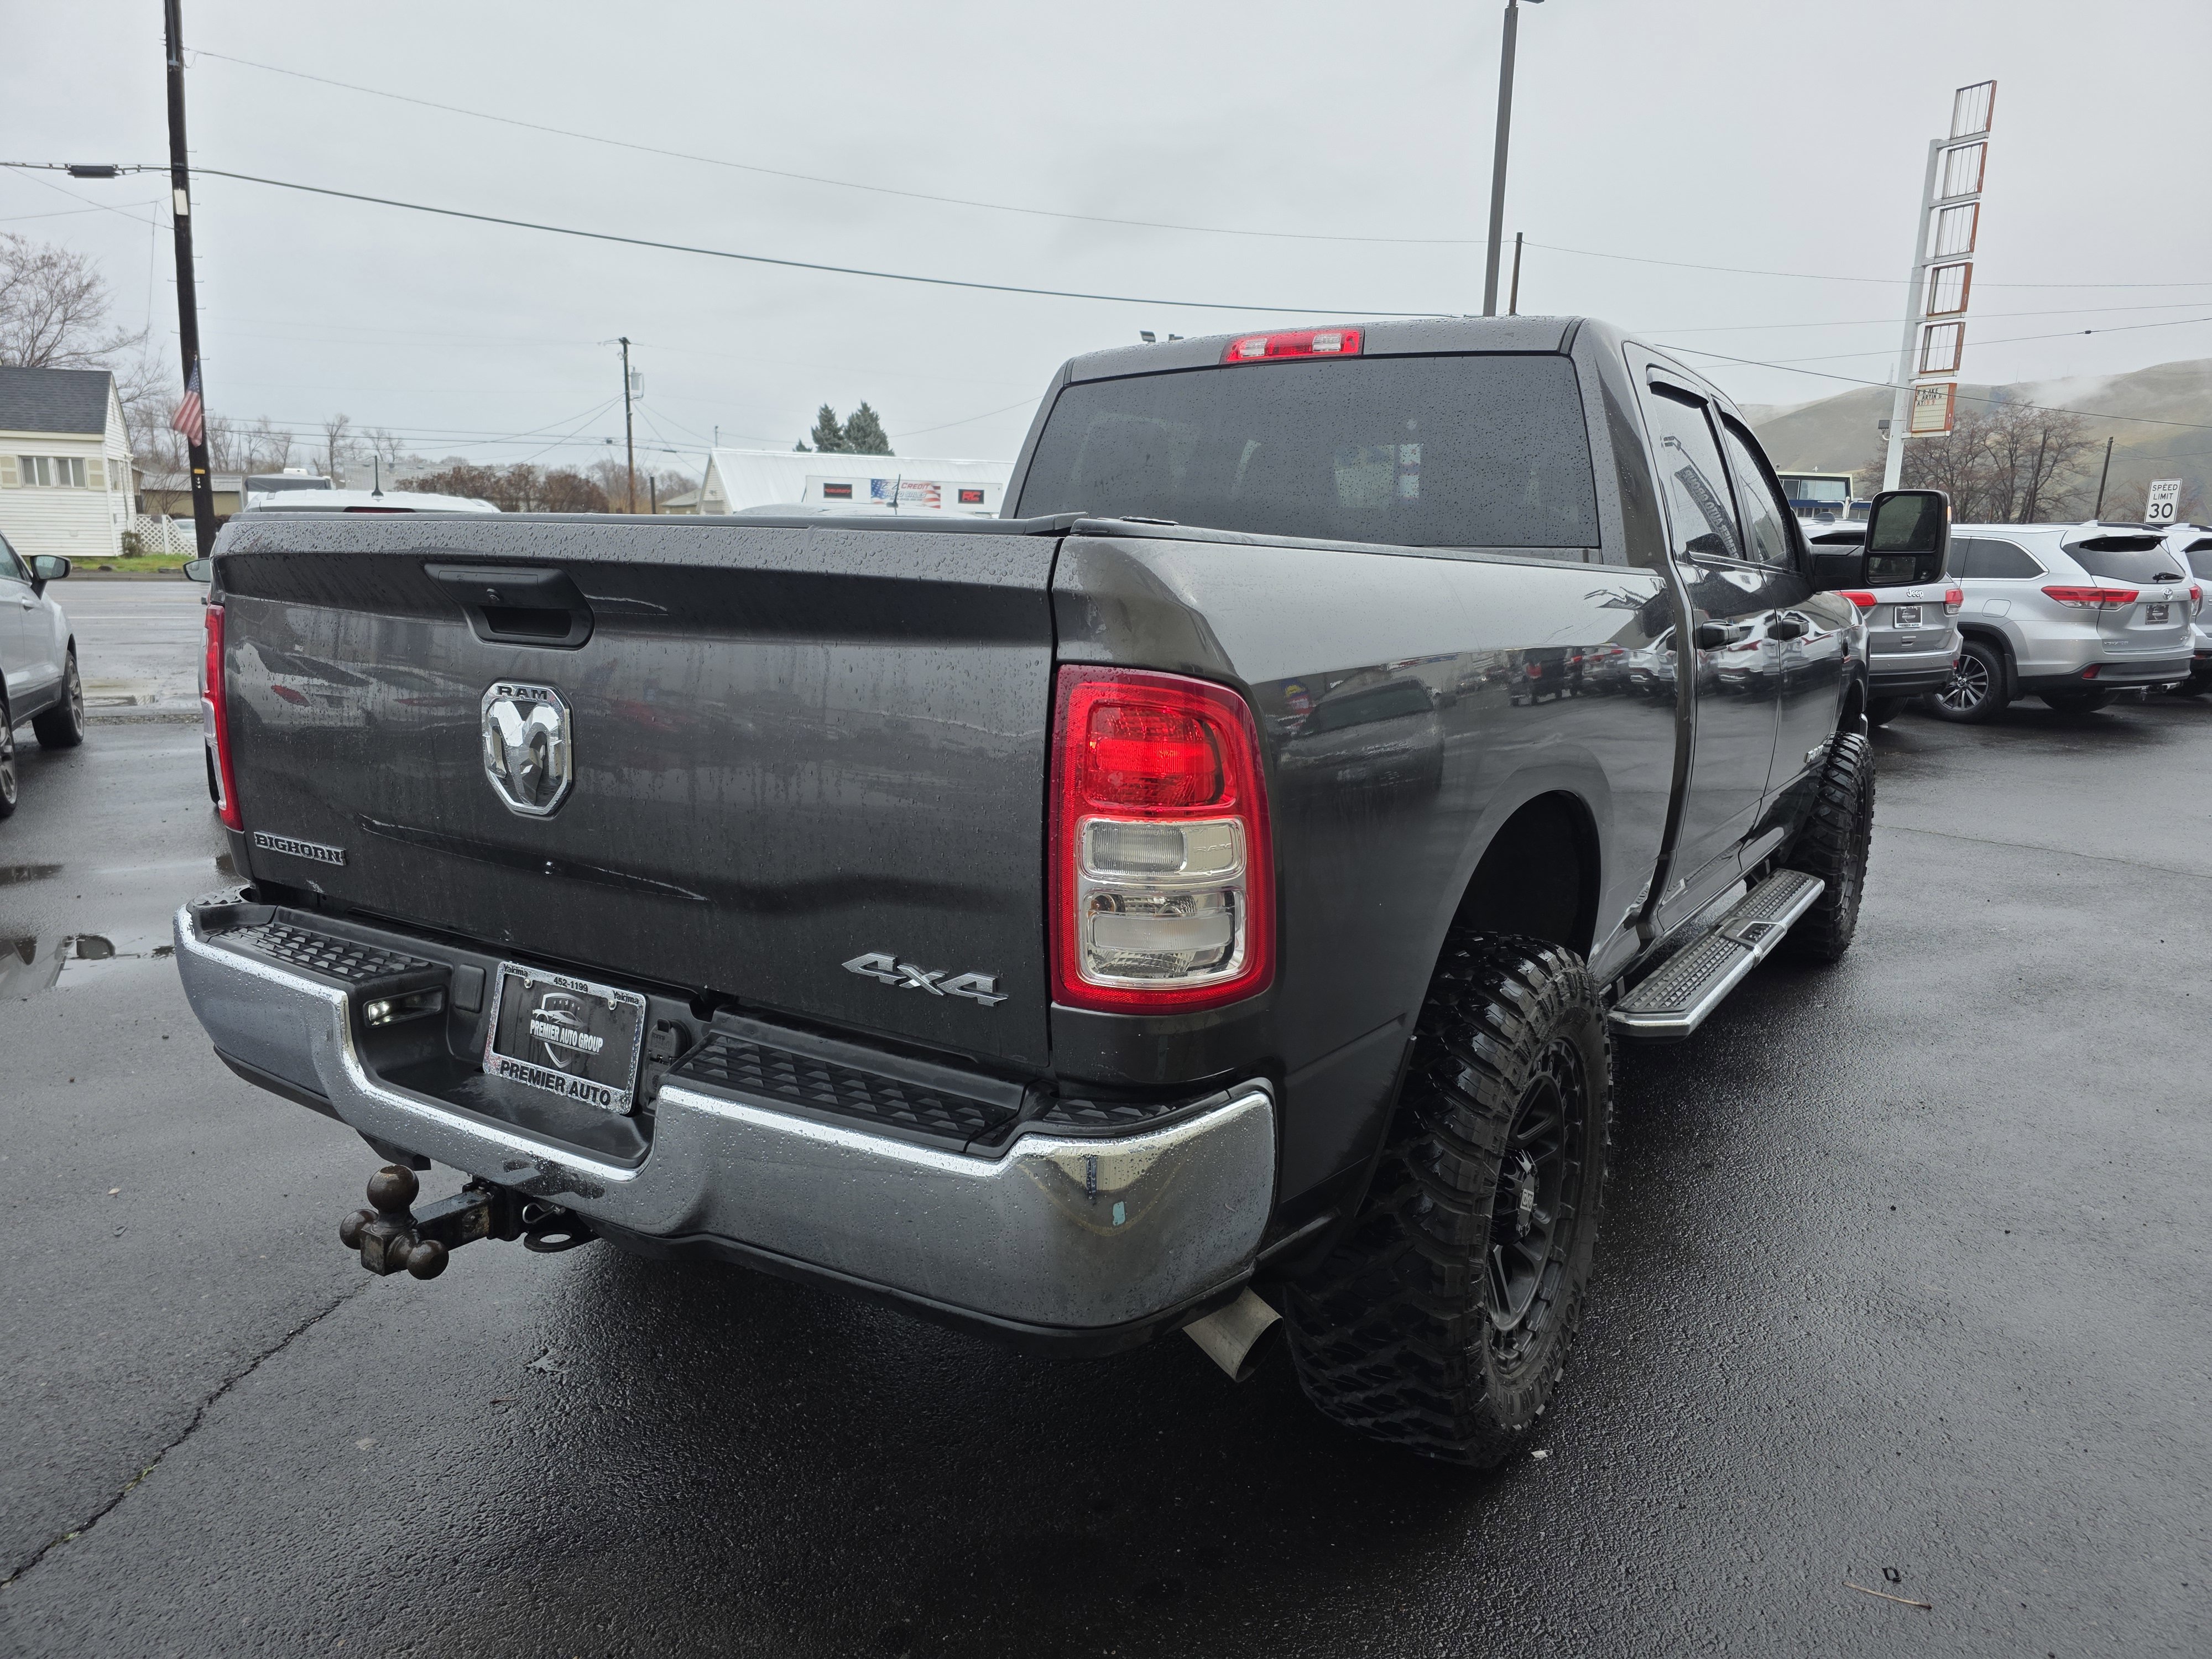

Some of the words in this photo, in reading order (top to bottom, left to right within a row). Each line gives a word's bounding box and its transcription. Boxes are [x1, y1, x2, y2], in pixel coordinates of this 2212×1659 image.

[2148, 503, 2173, 518] 30
[1906, 588, 1923, 599] Jeep
[498, 686, 548, 701] RAM
[254, 831, 345, 865] BIGHORN
[503, 964, 528, 977] Yakima
[553, 977, 588, 993] 452-1199
[613, 990, 639, 1005] Yakima
[530, 1019, 559, 1042] PREMIER
[560, 1027, 577, 1046] AUTO
[578, 1032, 603, 1053] GROUP
[500, 1060, 566, 1093] PREMIER
[569, 1081, 611, 1106] AUTO
